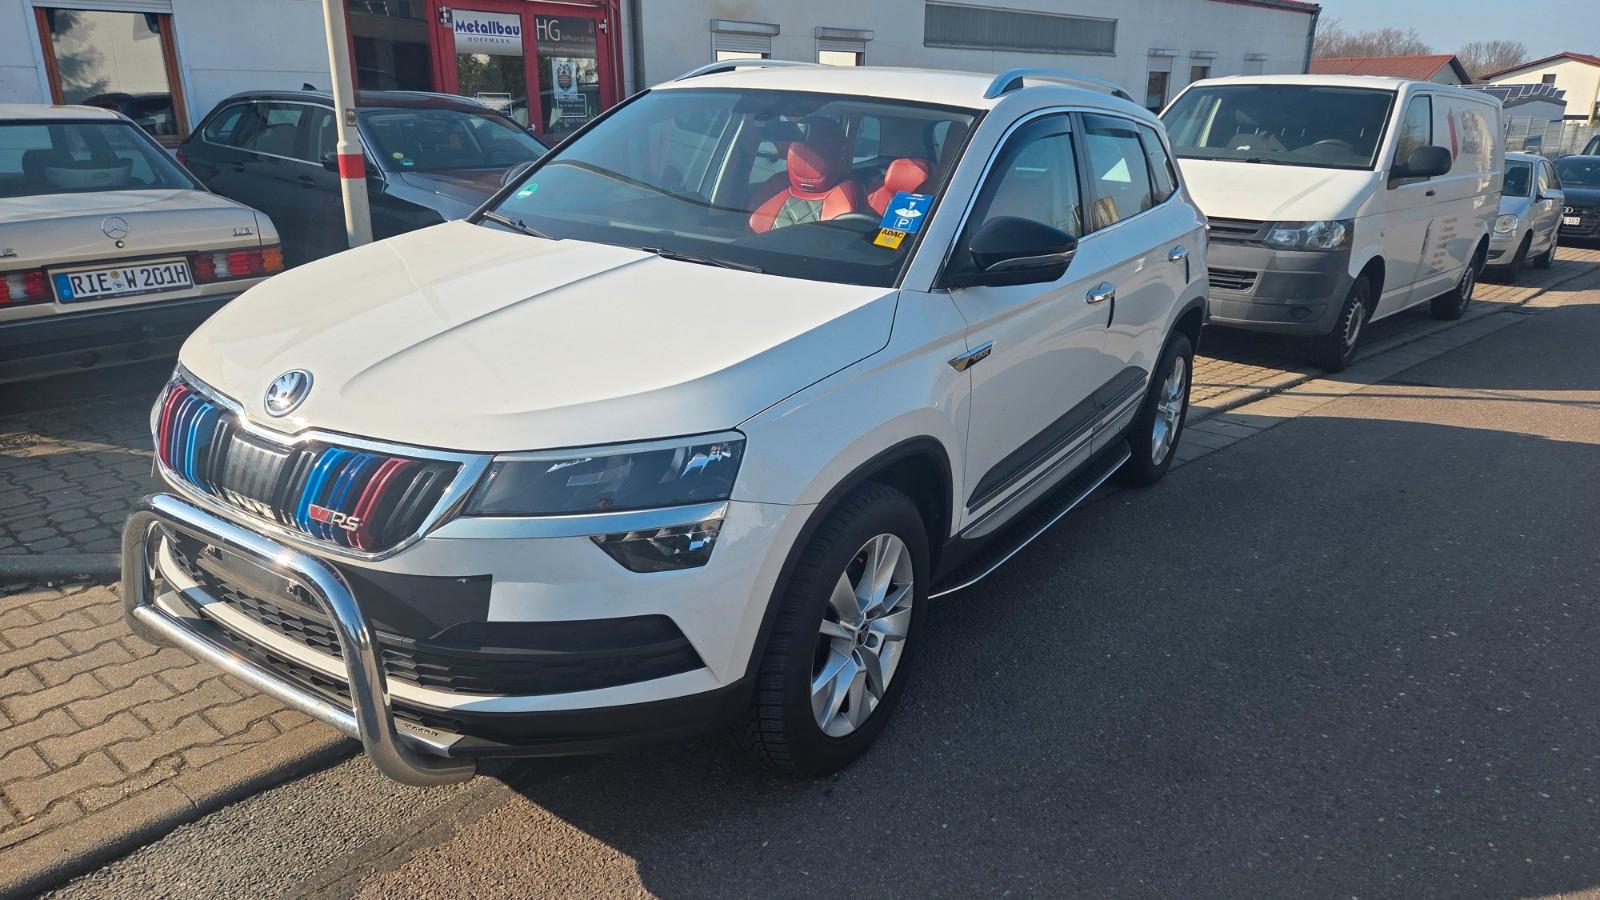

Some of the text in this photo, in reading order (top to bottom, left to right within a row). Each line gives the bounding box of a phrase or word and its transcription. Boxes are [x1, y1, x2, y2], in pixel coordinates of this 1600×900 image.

[455, 19, 520, 36] Metallbau
[535, 18, 561, 41] HG
[467, 36, 511, 44] HOFFMANN
[898, 218, 910, 228] P
[881, 229, 904, 239] ADAC
[70, 264, 188, 295] RIE W 201H
[330, 511, 361, 532] RS
